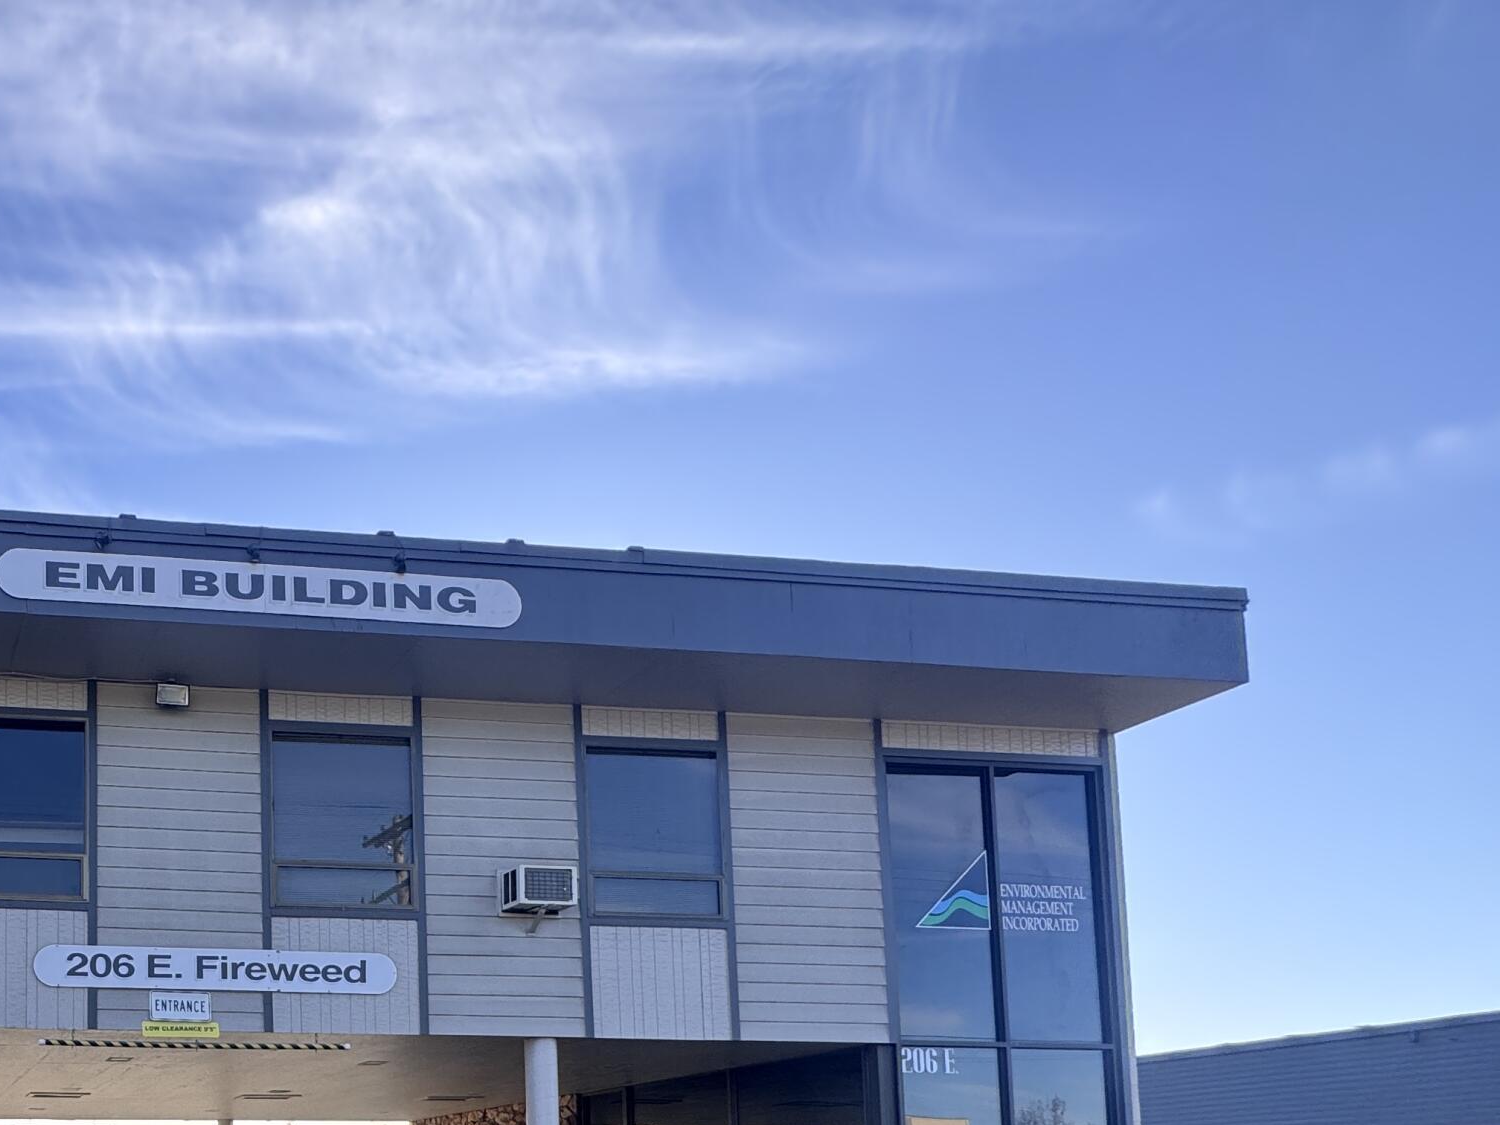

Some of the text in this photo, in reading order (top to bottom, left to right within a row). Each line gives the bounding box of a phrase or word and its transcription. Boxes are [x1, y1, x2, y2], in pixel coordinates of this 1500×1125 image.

[45, 561, 477, 613] EMI BUILDING
[1000, 884, 1087, 900] ENVIRONMENTAL
[1001, 900, 1074, 915] MANAGEMENT
[1002, 916, 1079, 932] INCORPORATED
[66, 952, 367, 984] 206 E. Fireweed
[155, 999, 206, 1013] ENTRANCE
[901, 1047, 960, 1074] 206 E.
